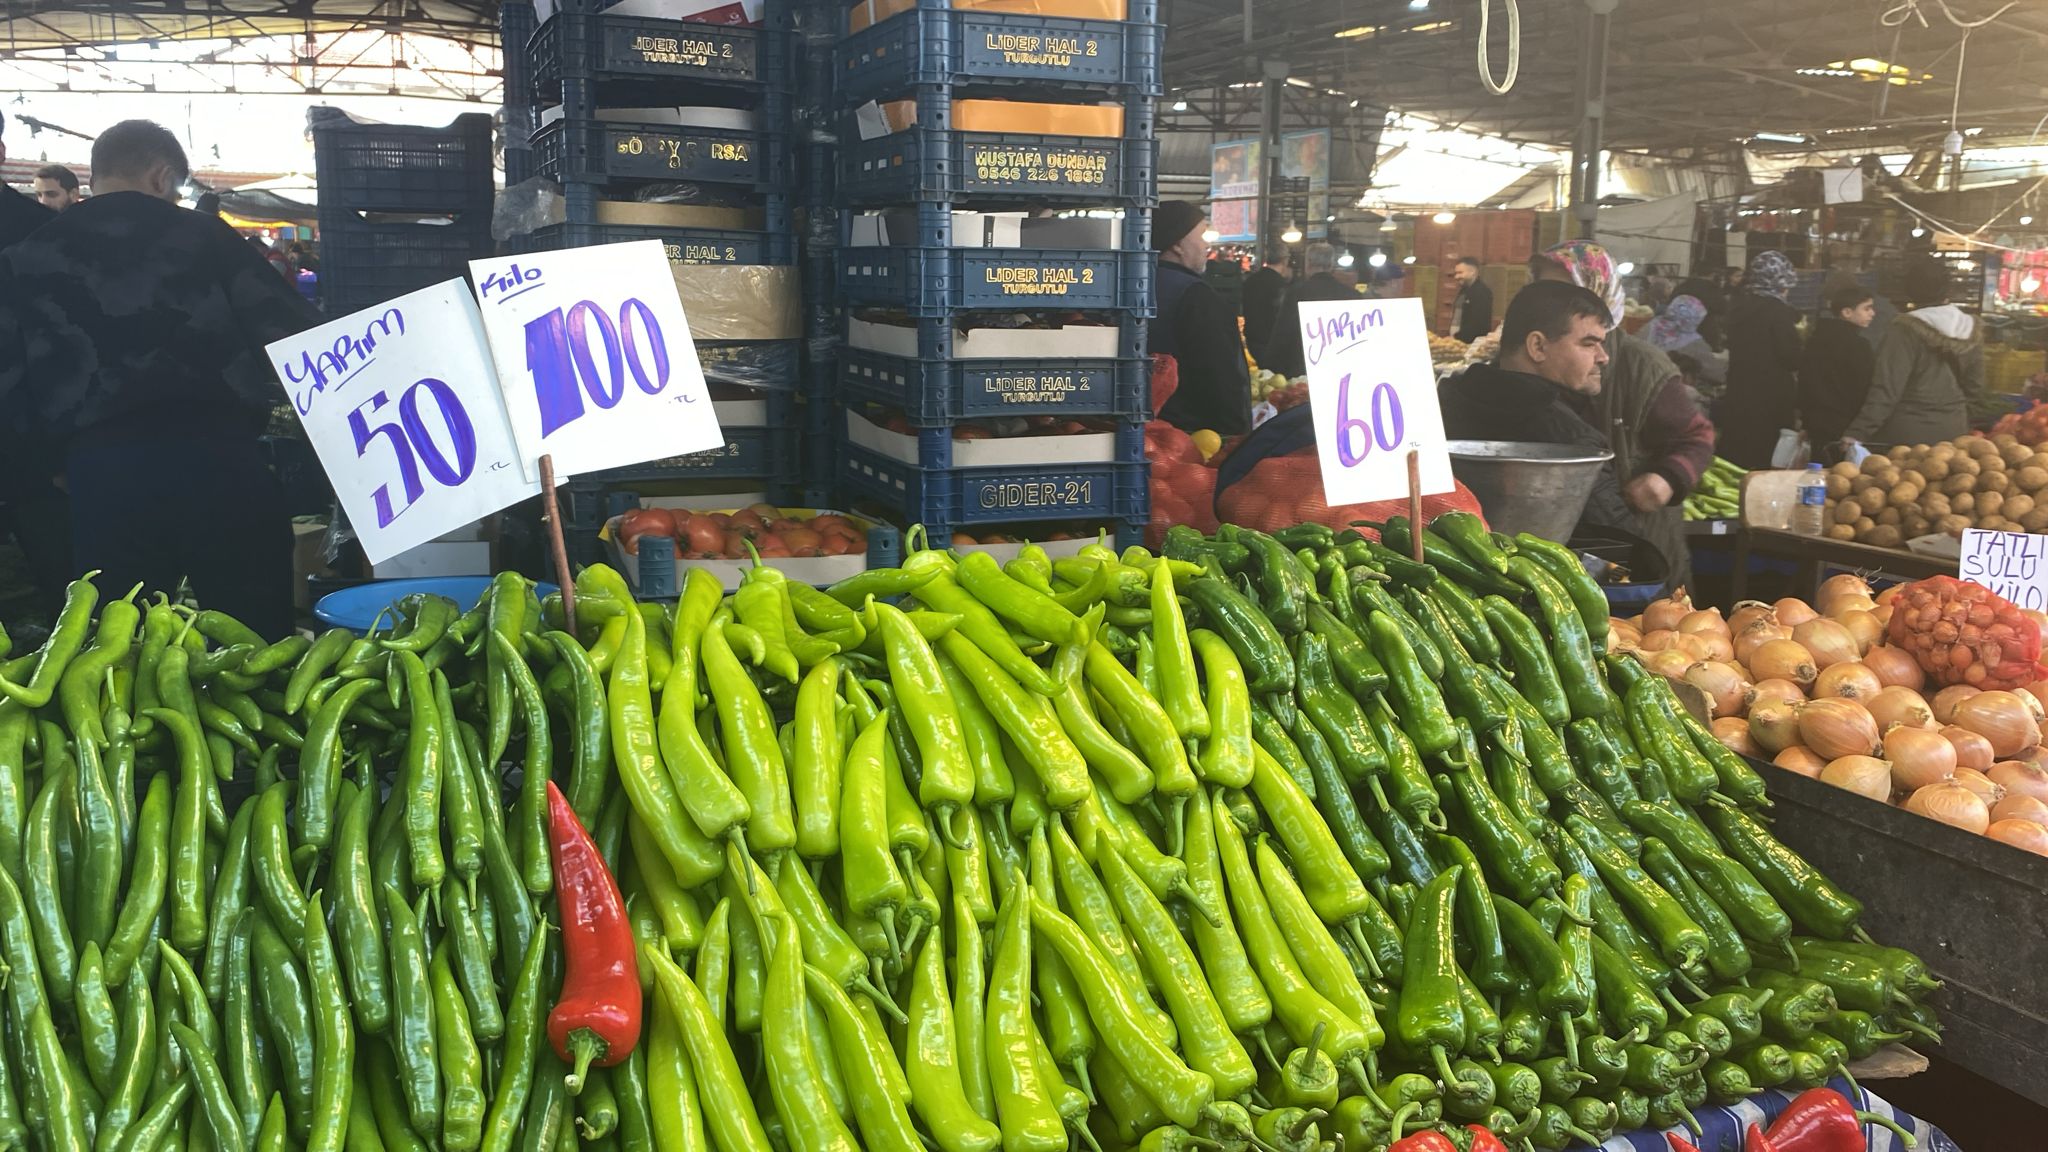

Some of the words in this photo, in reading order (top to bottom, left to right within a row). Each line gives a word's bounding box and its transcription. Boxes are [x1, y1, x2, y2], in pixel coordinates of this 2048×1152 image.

[683, 40, 718, 57] HAL
[722, 43, 733, 58] 2
[1045, 37, 1082, 55] HAL
[1086, 40, 1098, 56] 2
[1004, 51, 1071, 66] TURGUTLU
[975, 151, 1043, 168] MUSTAFA
[1046, 153, 1107, 171] DÜNDAR
[978, 166, 1020, 181] 0546
[1027, 168, 1059, 182] 226
[686, 245, 721, 260] HAL
[725, 247, 736, 261] 2
[1042, 268, 1079, 284] HAL
[1082, 268, 1094, 284] 2
[1002, 283, 1068, 294] TURGUTLU
[524, 297, 671, 440] 100
[1041, 376, 1077, 391] HAL
[1080, 376, 1091, 391] 2
[1001, 391, 1065, 403] TURGUTLU
[1336, 372, 1405, 468] 60
[347, 378, 477, 529] 50
[729, 443, 740, 456] 2
[1970, 531, 2045, 560] TATLI
[1963, 554, 2036, 580] SULU
